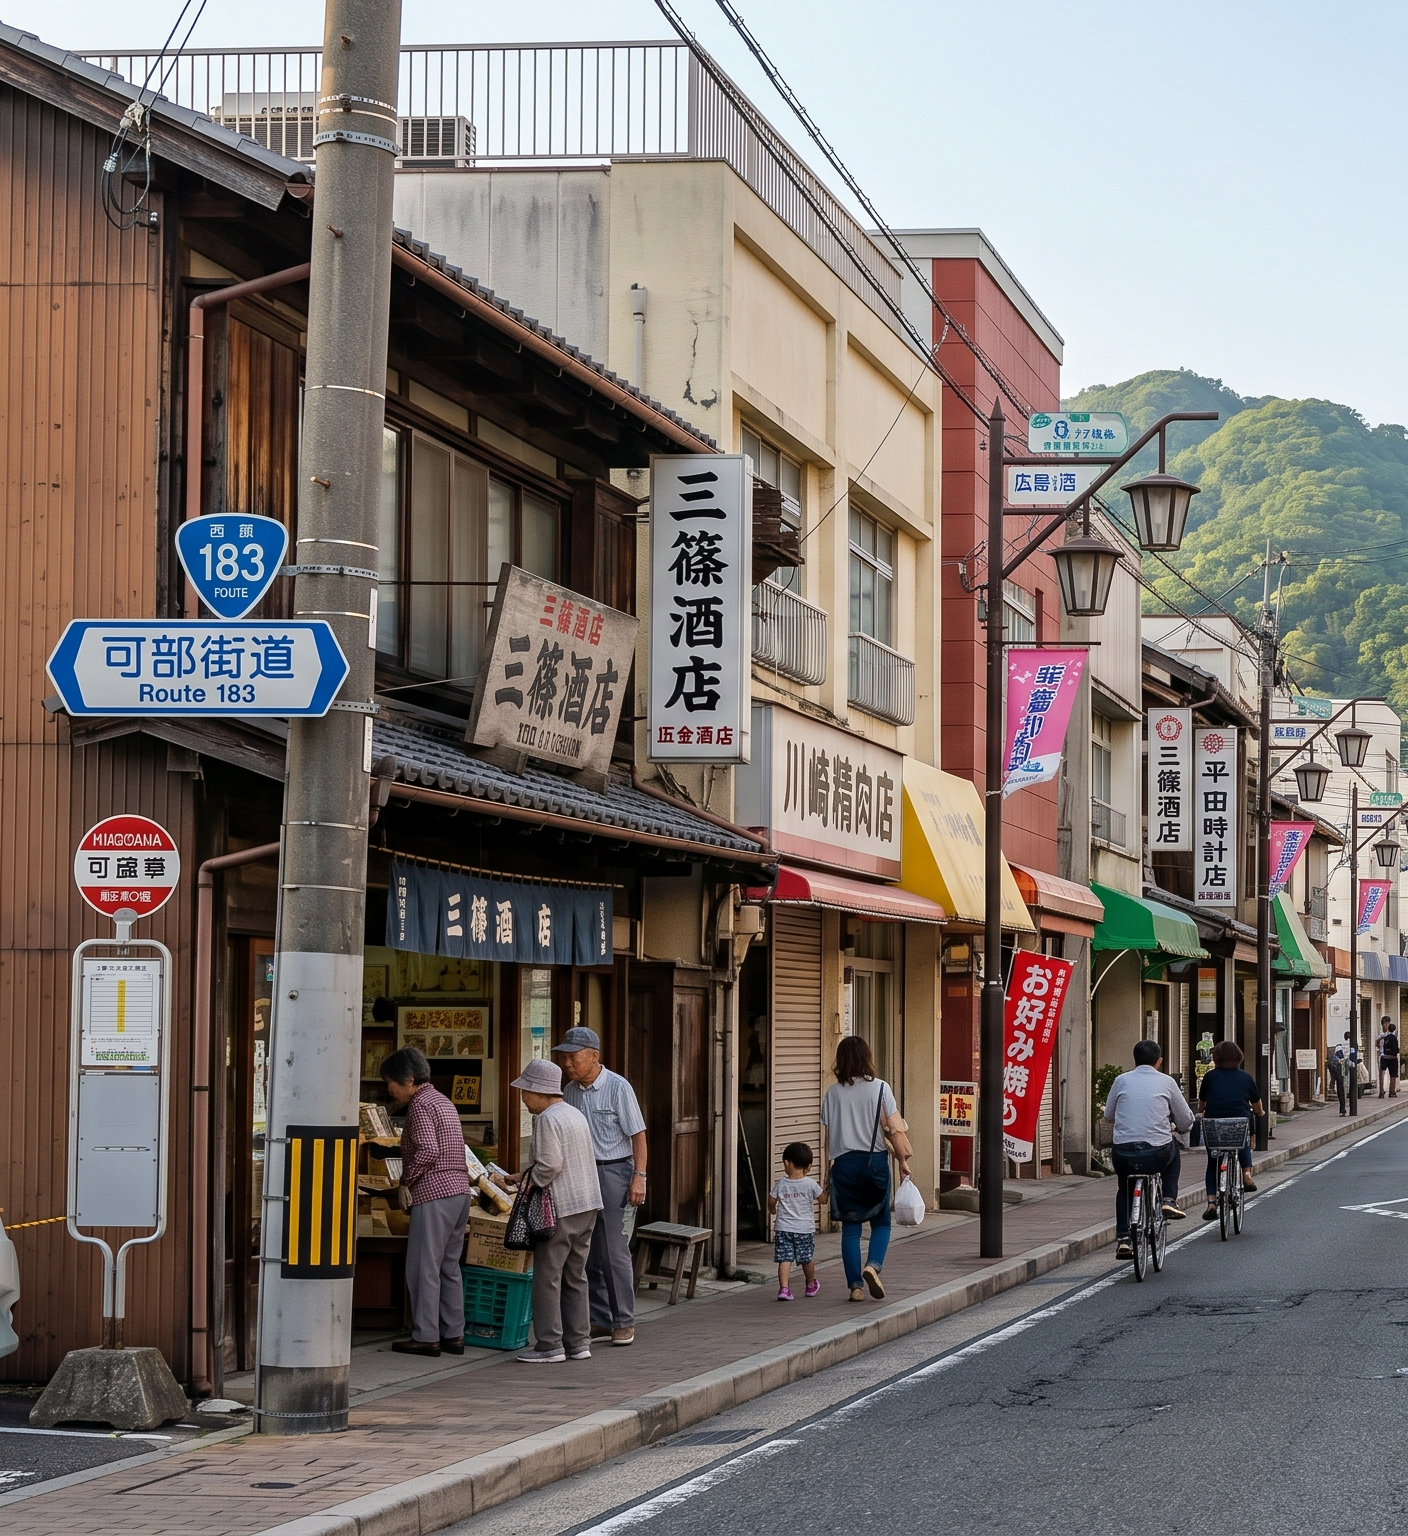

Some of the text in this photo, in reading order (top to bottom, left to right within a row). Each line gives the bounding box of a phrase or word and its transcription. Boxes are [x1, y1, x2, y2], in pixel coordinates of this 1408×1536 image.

[199, 542, 265, 582] 183
[664, 470, 729, 713] 三篠酒店
[102, 634, 295, 680] 可部街道
[139, 683, 256, 703] Route 183
[494, 634, 619, 737] 三篠酒店
[784, 739, 894, 844] 川崎精肉店
[1156, 746, 1181, 844] 三篠酒店
[1201, 761, 1230, 887] 平田時計店
